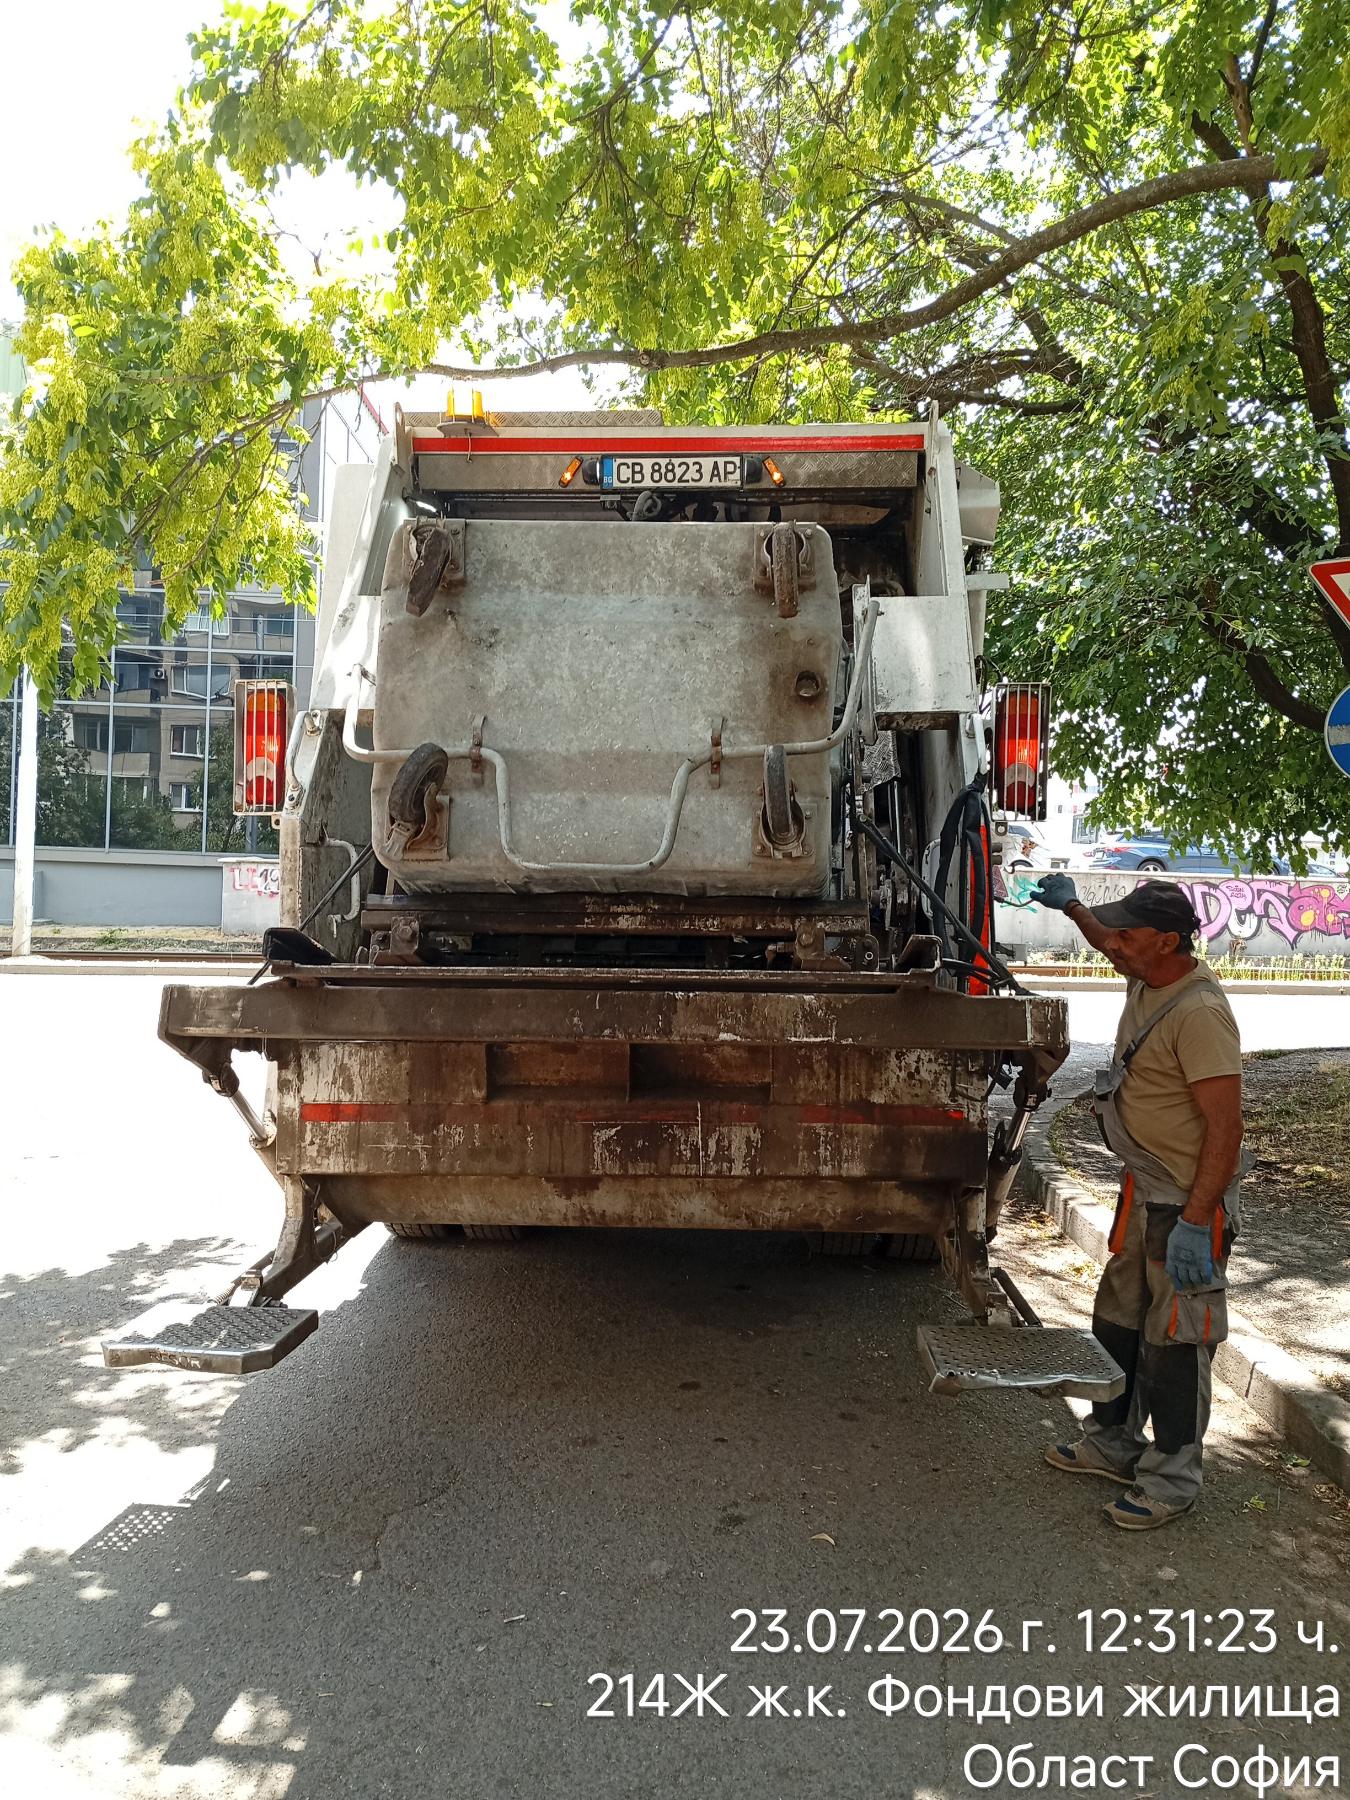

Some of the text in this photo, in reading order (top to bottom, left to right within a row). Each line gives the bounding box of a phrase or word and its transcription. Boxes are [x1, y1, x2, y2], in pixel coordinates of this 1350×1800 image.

[616, 460, 738, 484] CB 8823 AP
